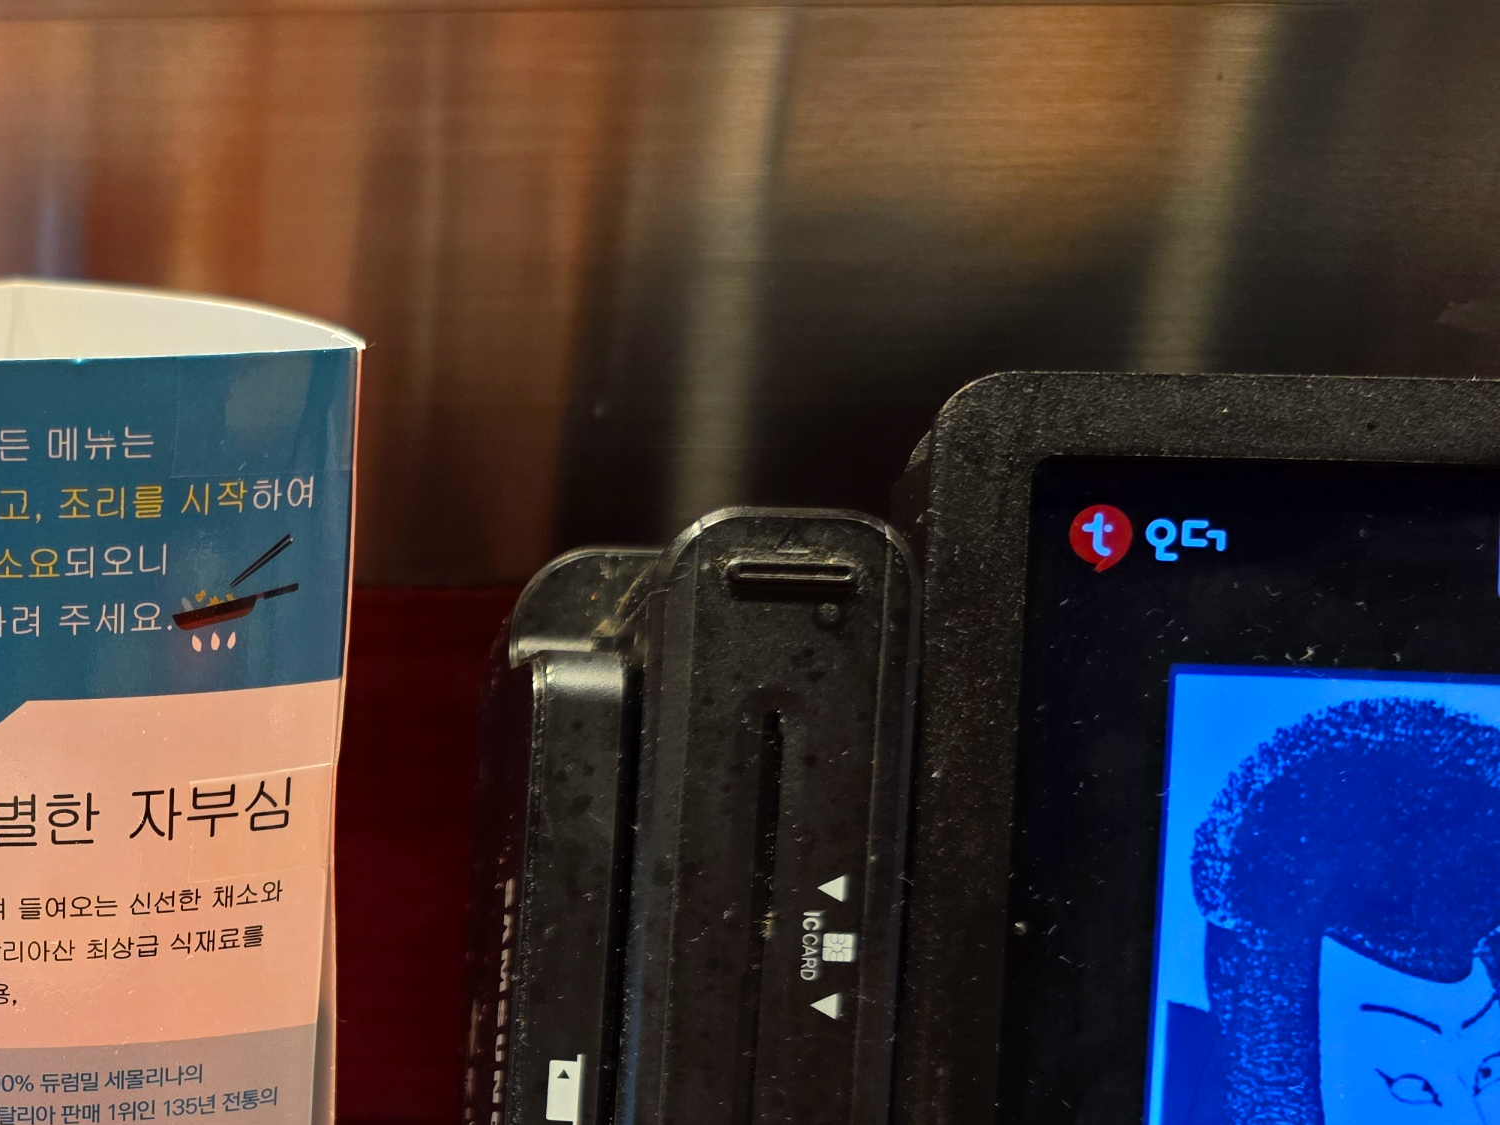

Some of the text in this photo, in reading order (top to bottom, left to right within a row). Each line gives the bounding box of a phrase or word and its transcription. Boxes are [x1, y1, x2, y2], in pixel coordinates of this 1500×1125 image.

[49, 426, 154, 461] 메뉴는
[58, 486, 164, 519] 조리를
[181, 475, 313, 515] 시작하여
[59, 603, 172, 635] 주세요.
[129, 777, 291, 841] 자부심
[19, 896, 117, 920] 들여오는
[130, 888, 201, 915] 신선한
[212, 880, 283, 908] 채소와
[87, 935, 159, 960] 최상급
[171, 925, 263, 954] 식재료를
[800, 935, 820, 982] CARD
[40, 1072, 98, 1093] 듀럼밀
[104, 1064, 202, 1090] 세몰리나의
[61, 1103, 100, 1124] 판매
[108, 1100, 155, 1121] 1위인
[164, 1094, 215, 1116] 135년
[222, 1086, 277, 1112] 전통의
